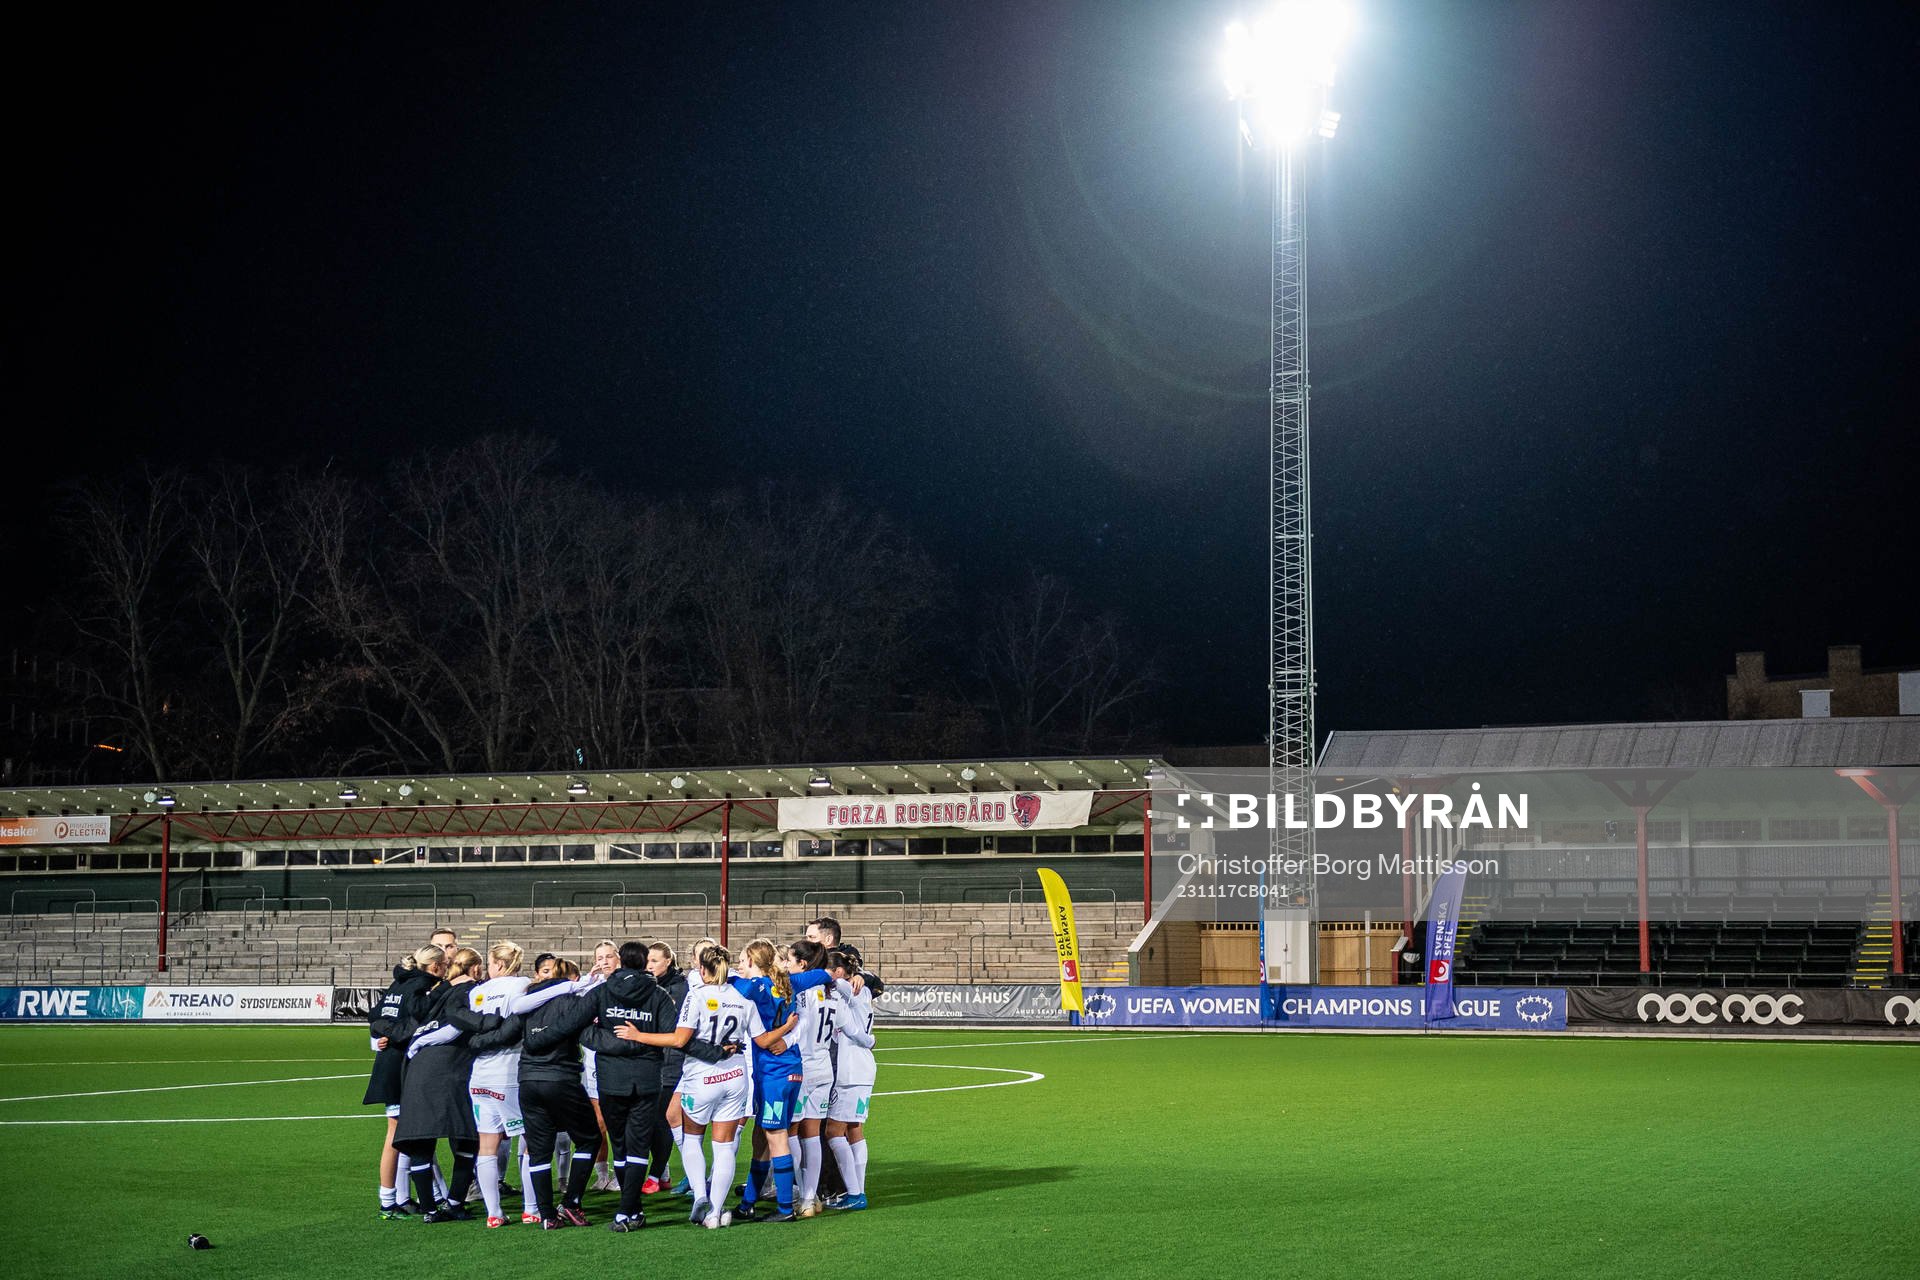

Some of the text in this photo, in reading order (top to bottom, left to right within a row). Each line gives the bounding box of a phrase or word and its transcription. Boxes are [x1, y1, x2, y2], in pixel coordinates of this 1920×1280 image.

[827, 796, 1006, 825] FORZA ROSENGÅRD
[1434, 902, 1448, 956] SVENSKA
[1443, 928, 1454, 956] SPEL
[17, 990, 90, 1016] RWE
[169, 994, 234, 1008] TREANO
[240, 998, 312, 1009] SYDSVENSKAN
[882, 991, 911, 1003] OCH
[914, 988, 962, 1004] MÖTEN
[974, 986, 1010, 1004] ÅHUS
[606, 1006, 652, 1022] stadium
[1127, 998, 1175, 1014] UEFA
[1282, 999, 1412, 1016] CHAMPIONS
[709, 1015, 738, 1044] 12
[816, 1007, 836, 1043] 15
[704, 1069, 743, 1084] BAUHAUS
